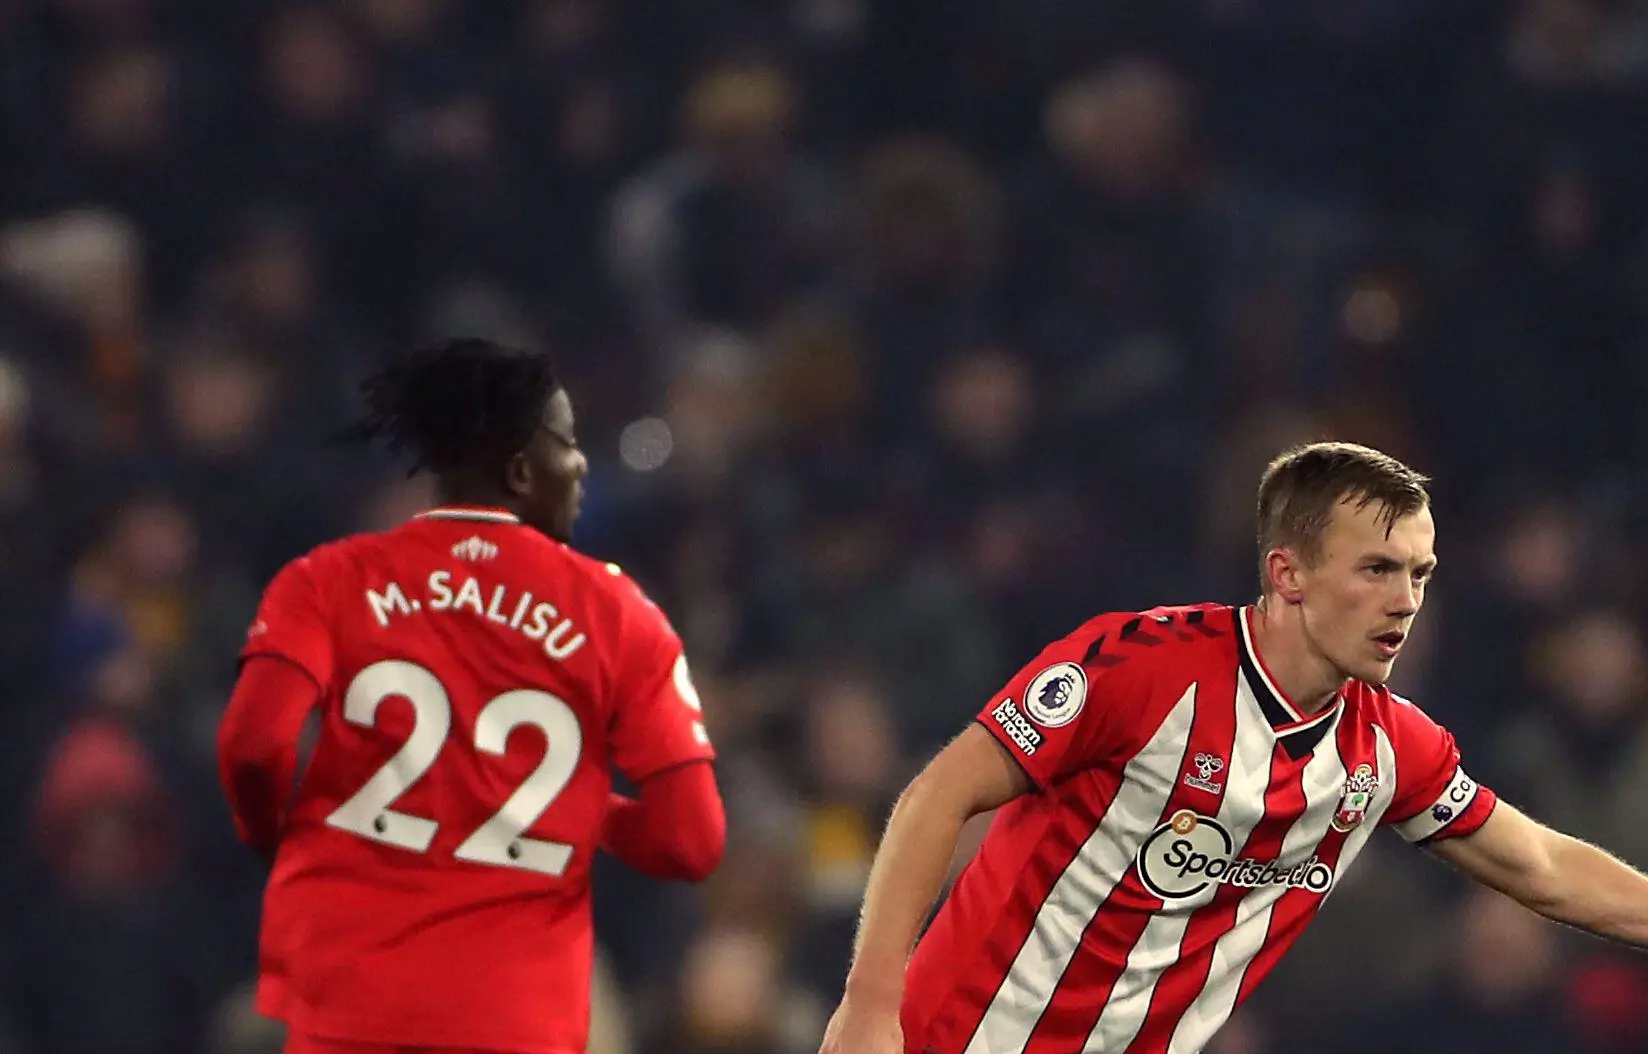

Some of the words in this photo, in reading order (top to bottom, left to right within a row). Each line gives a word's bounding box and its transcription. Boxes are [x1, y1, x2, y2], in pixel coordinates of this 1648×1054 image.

[366, 582, 422, 627] M.
[427, 570, 587, 660] SALISU
[324, 659, 583, 877] 22
[1011, 712, 1041, 745] room
